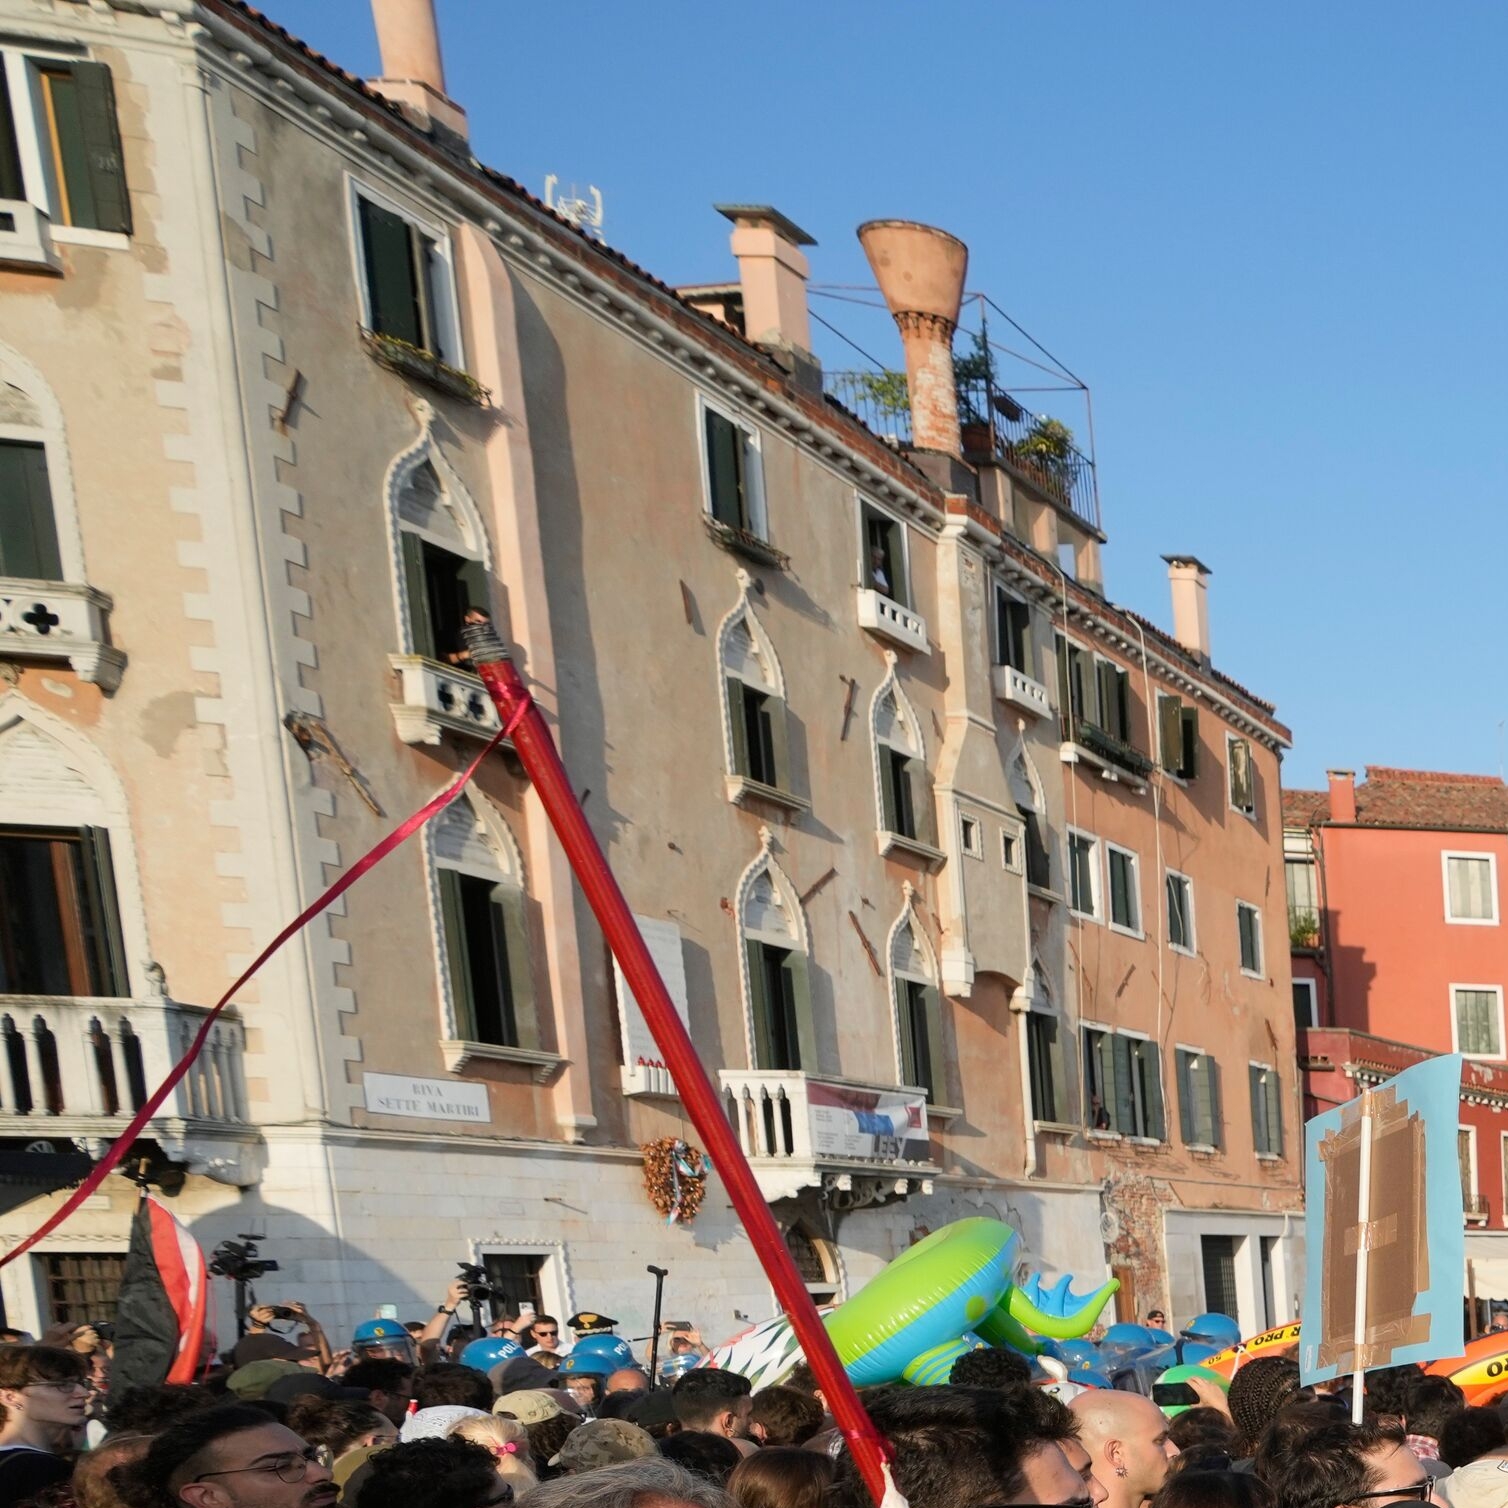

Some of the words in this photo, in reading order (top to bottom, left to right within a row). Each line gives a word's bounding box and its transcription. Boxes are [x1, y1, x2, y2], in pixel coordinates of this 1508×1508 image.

[412, 1083, 443, 1097] RIVA
[377, 1097, 421, 1112] SETTE
[427, 1101, 480, 1117] MARTIRI
